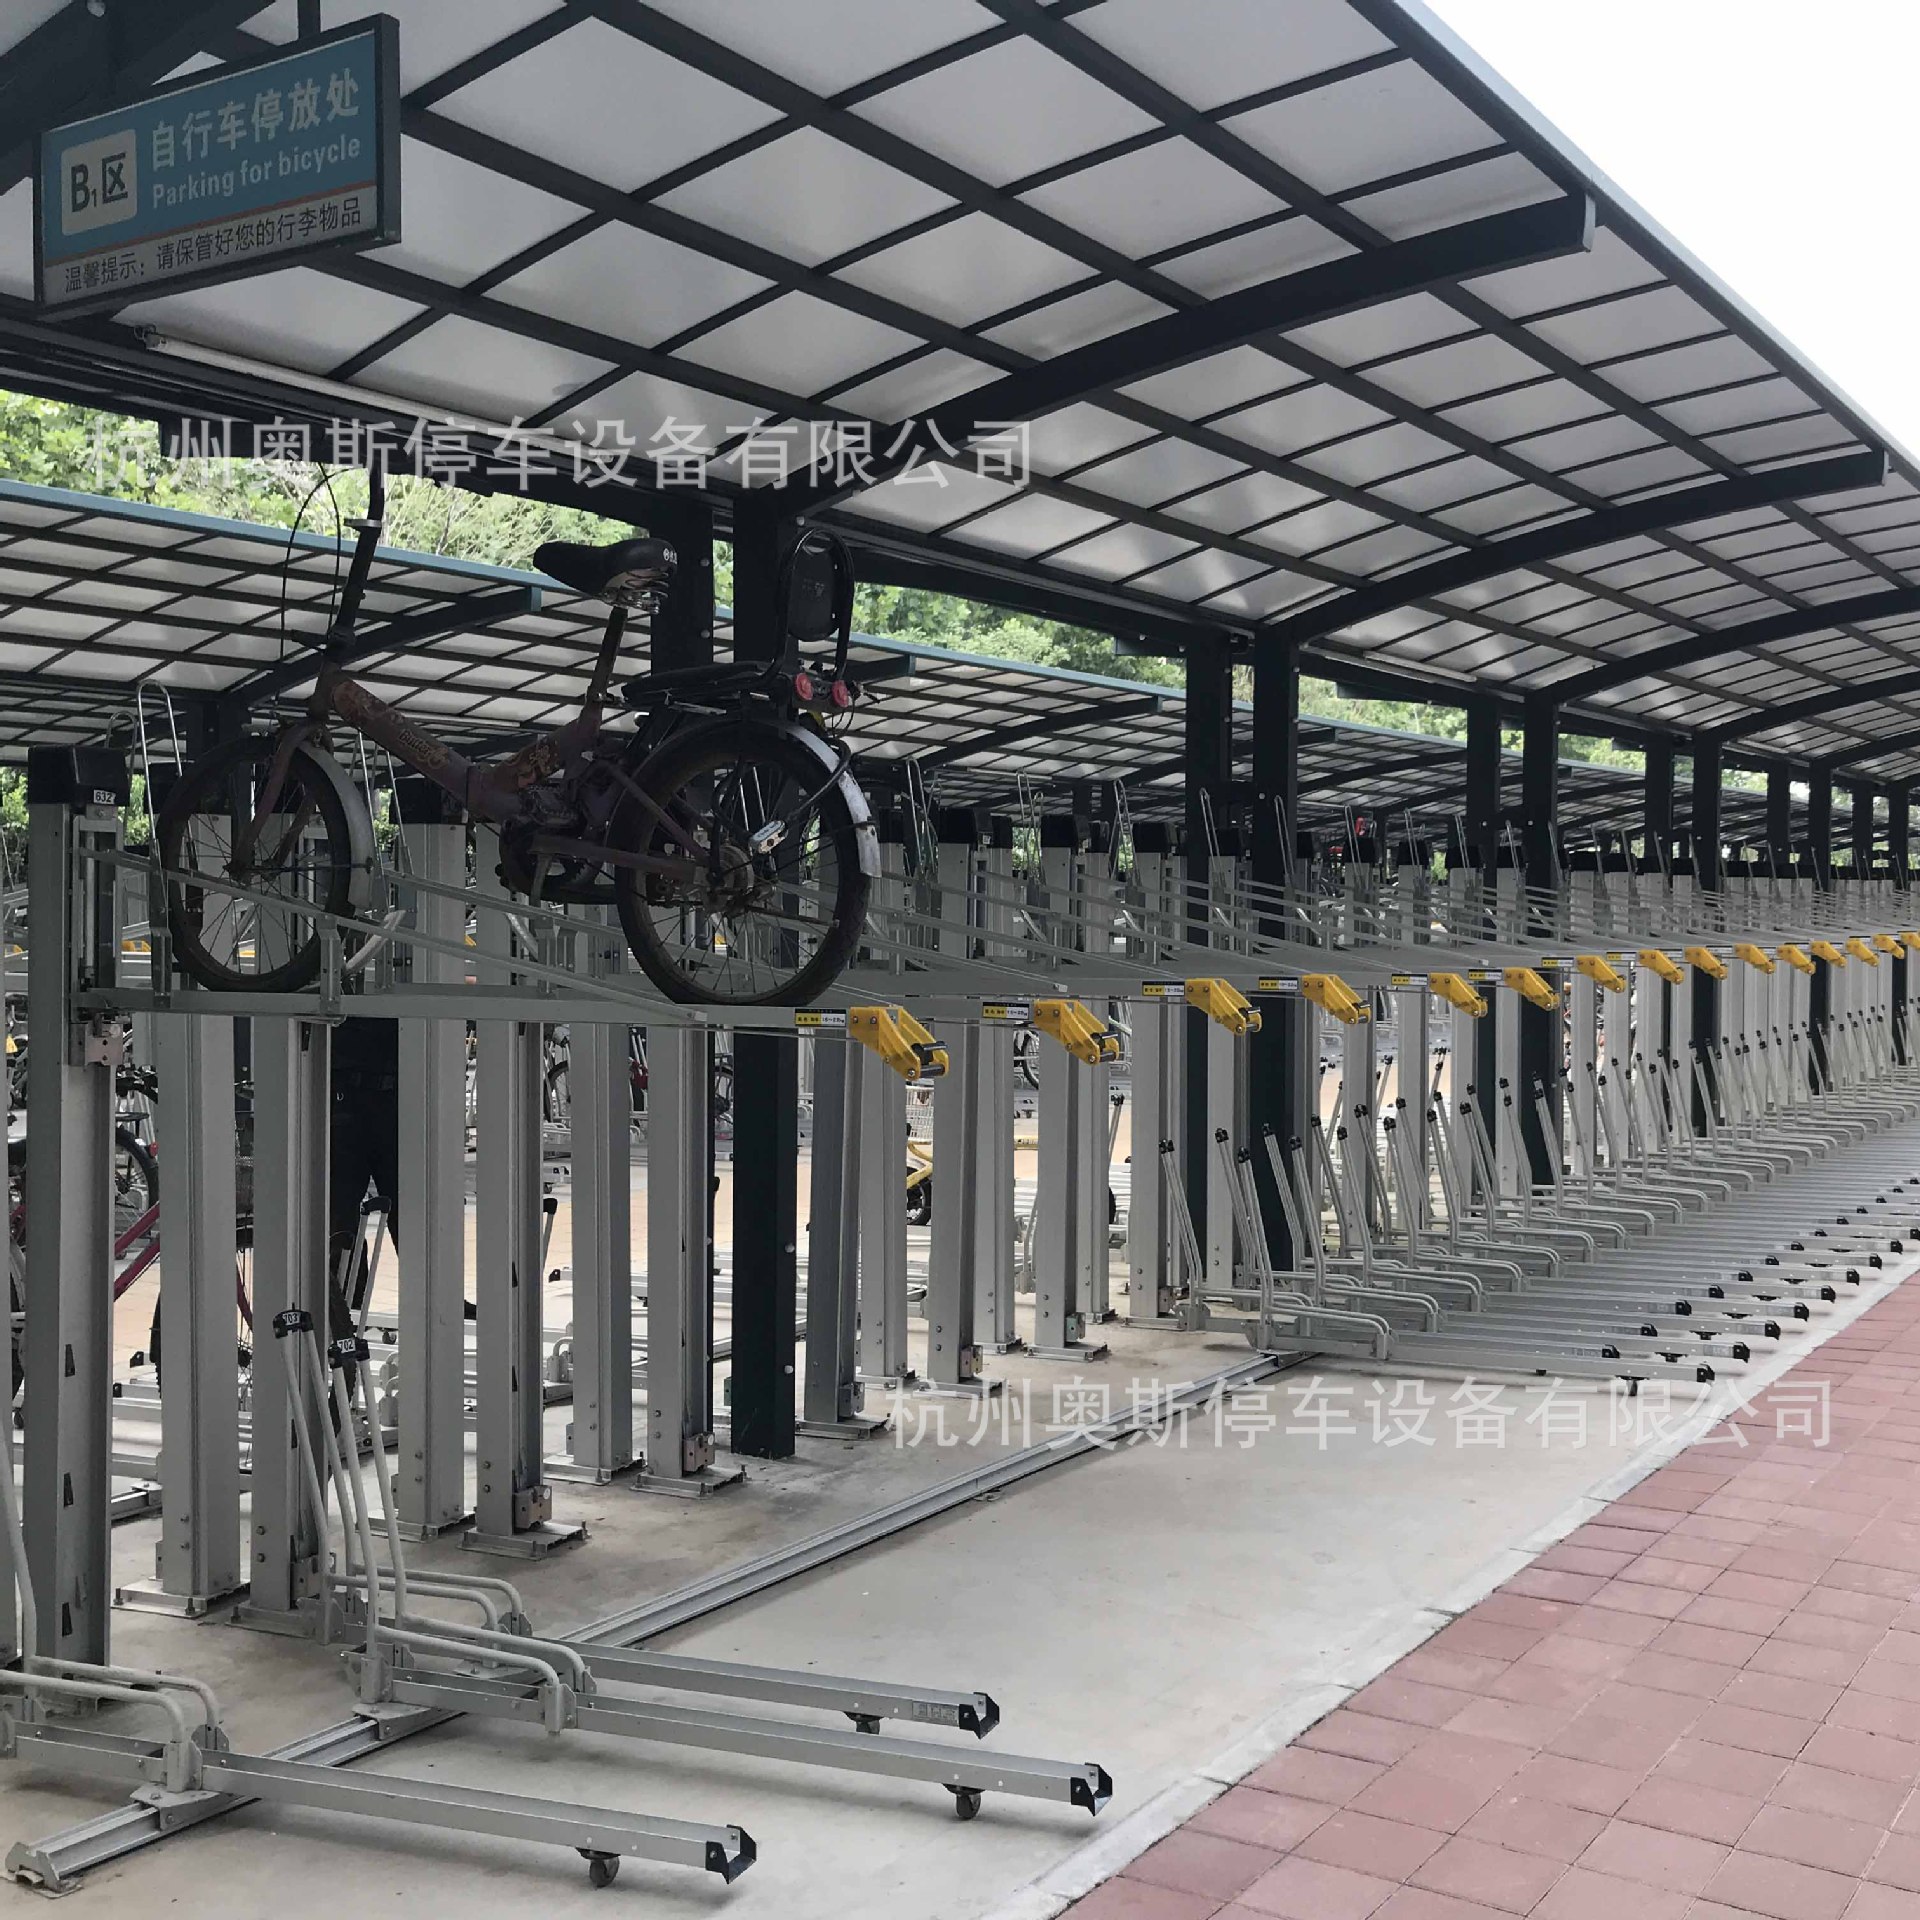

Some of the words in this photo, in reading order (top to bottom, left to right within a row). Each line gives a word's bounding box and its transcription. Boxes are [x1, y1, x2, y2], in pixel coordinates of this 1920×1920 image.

[152, 67, 360, 172] 自行车停放处
[152, 166, 235, 209] Parking
[240, 159, 274, 186] for
[278, 134, 361, 177] bicycle
[95, 791, 113, 803] 632
[283, 1313, 298, 1324] 703
[338, 1339, 354, 1351] 702
